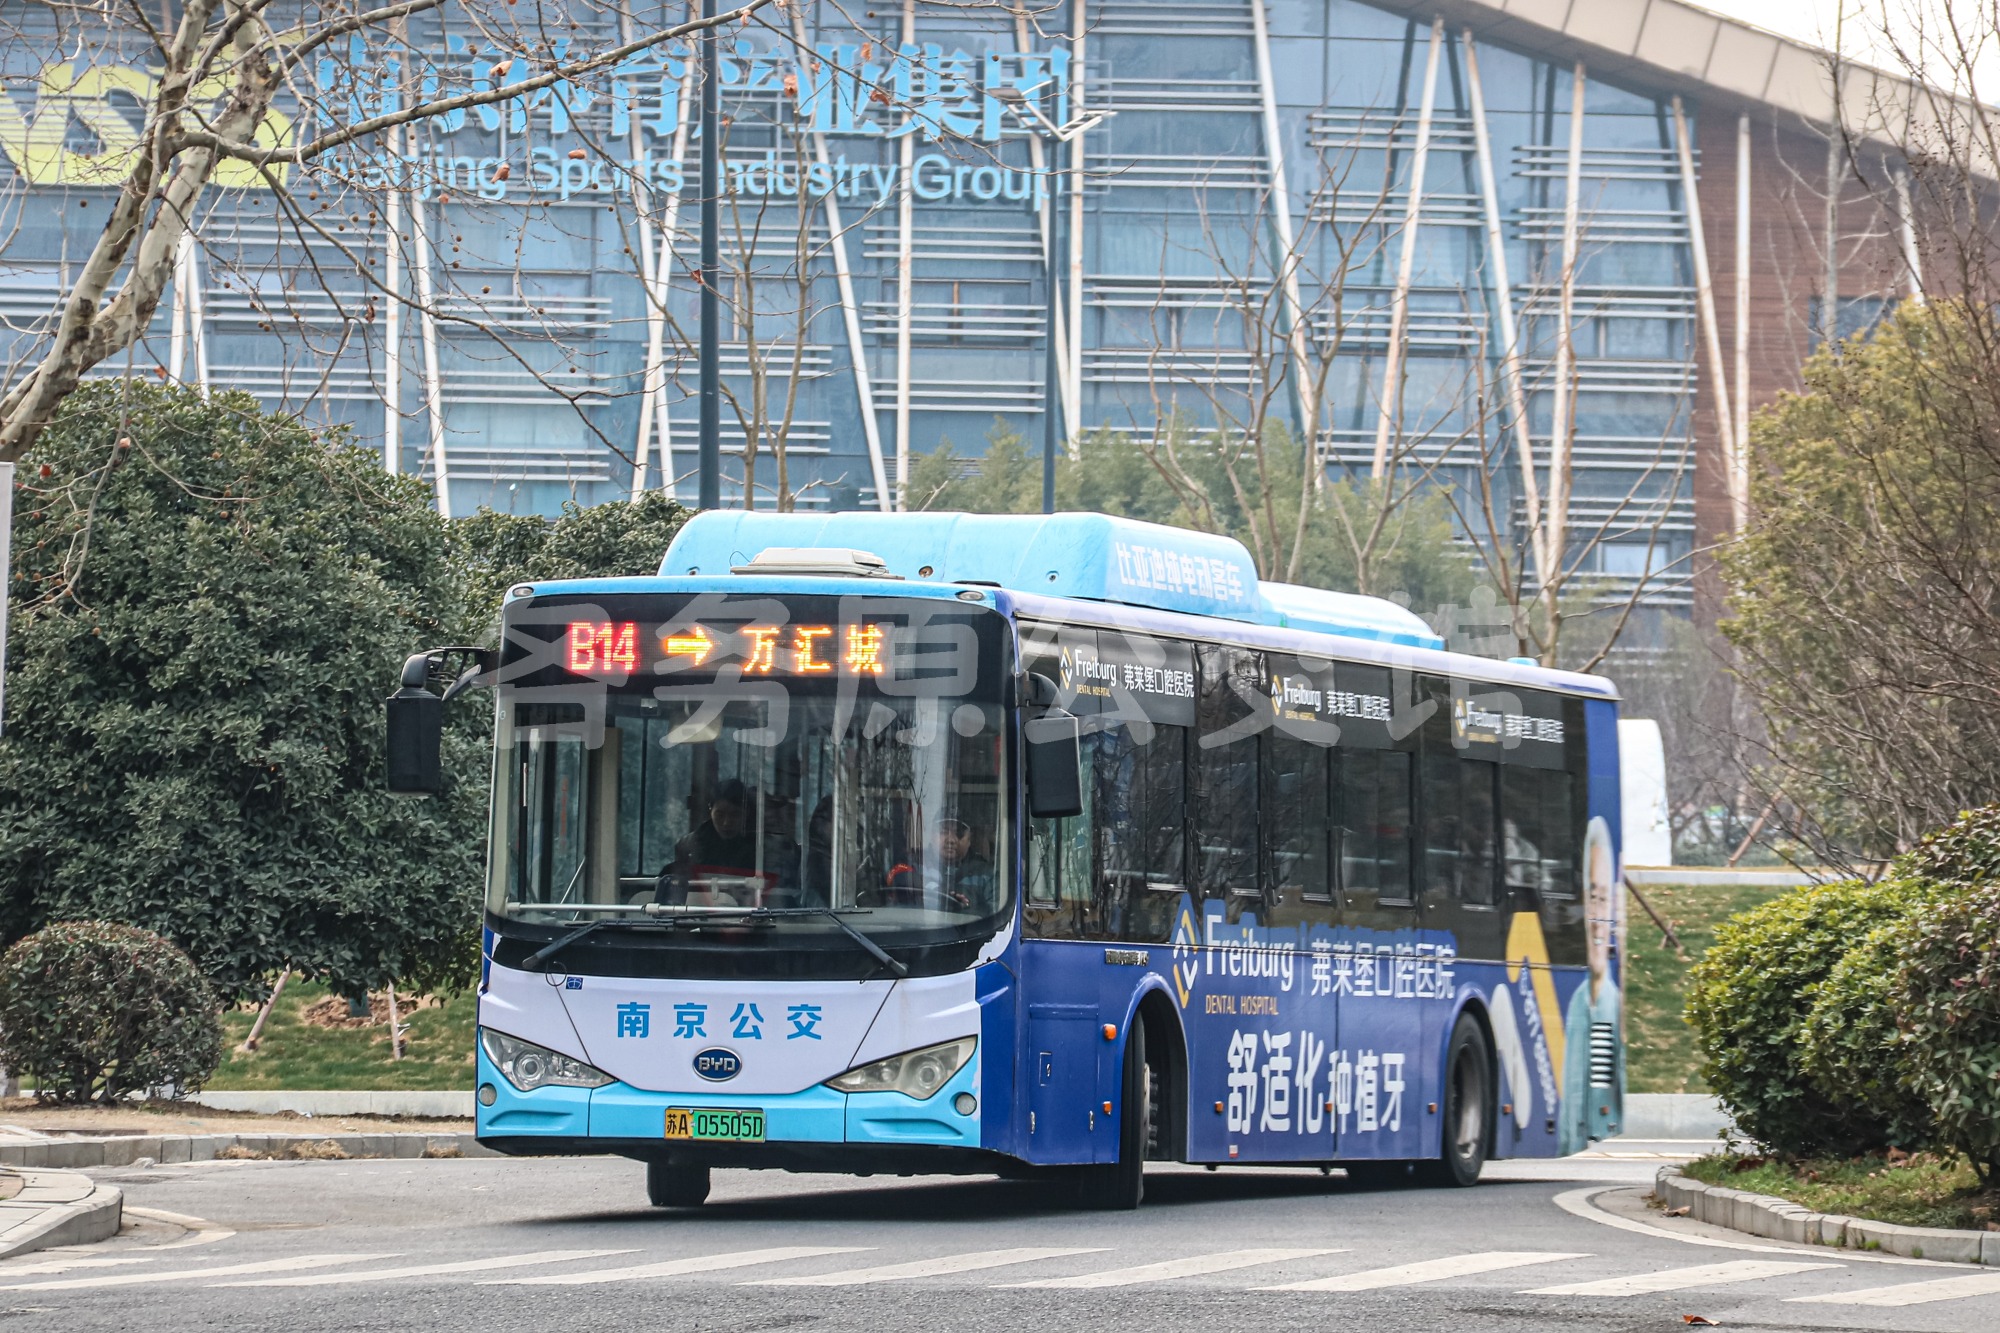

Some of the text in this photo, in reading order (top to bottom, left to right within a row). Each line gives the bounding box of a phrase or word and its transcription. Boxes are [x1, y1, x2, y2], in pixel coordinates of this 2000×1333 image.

[531, 146, 684, 202] Sports
[717, 150, 898, 209] ndustry
[911, 153, 1064, 212] Group
[1115, 541, 1244, 603] 比亚迪纯电动客车
[568, 621, 884, 674] B14 万汇城
[1075, 649, 1117, 687] Freiburg
[1283, 677, 1322, 712] Freiburg
[1206, 914, 1295, 992] Freiburg
[616, 1002, 823, 1041] 南京公交
[1205, 995, 1280, 1016] DENTAL HOSPITAL
[698, 1057, 736, 1071] BYD
